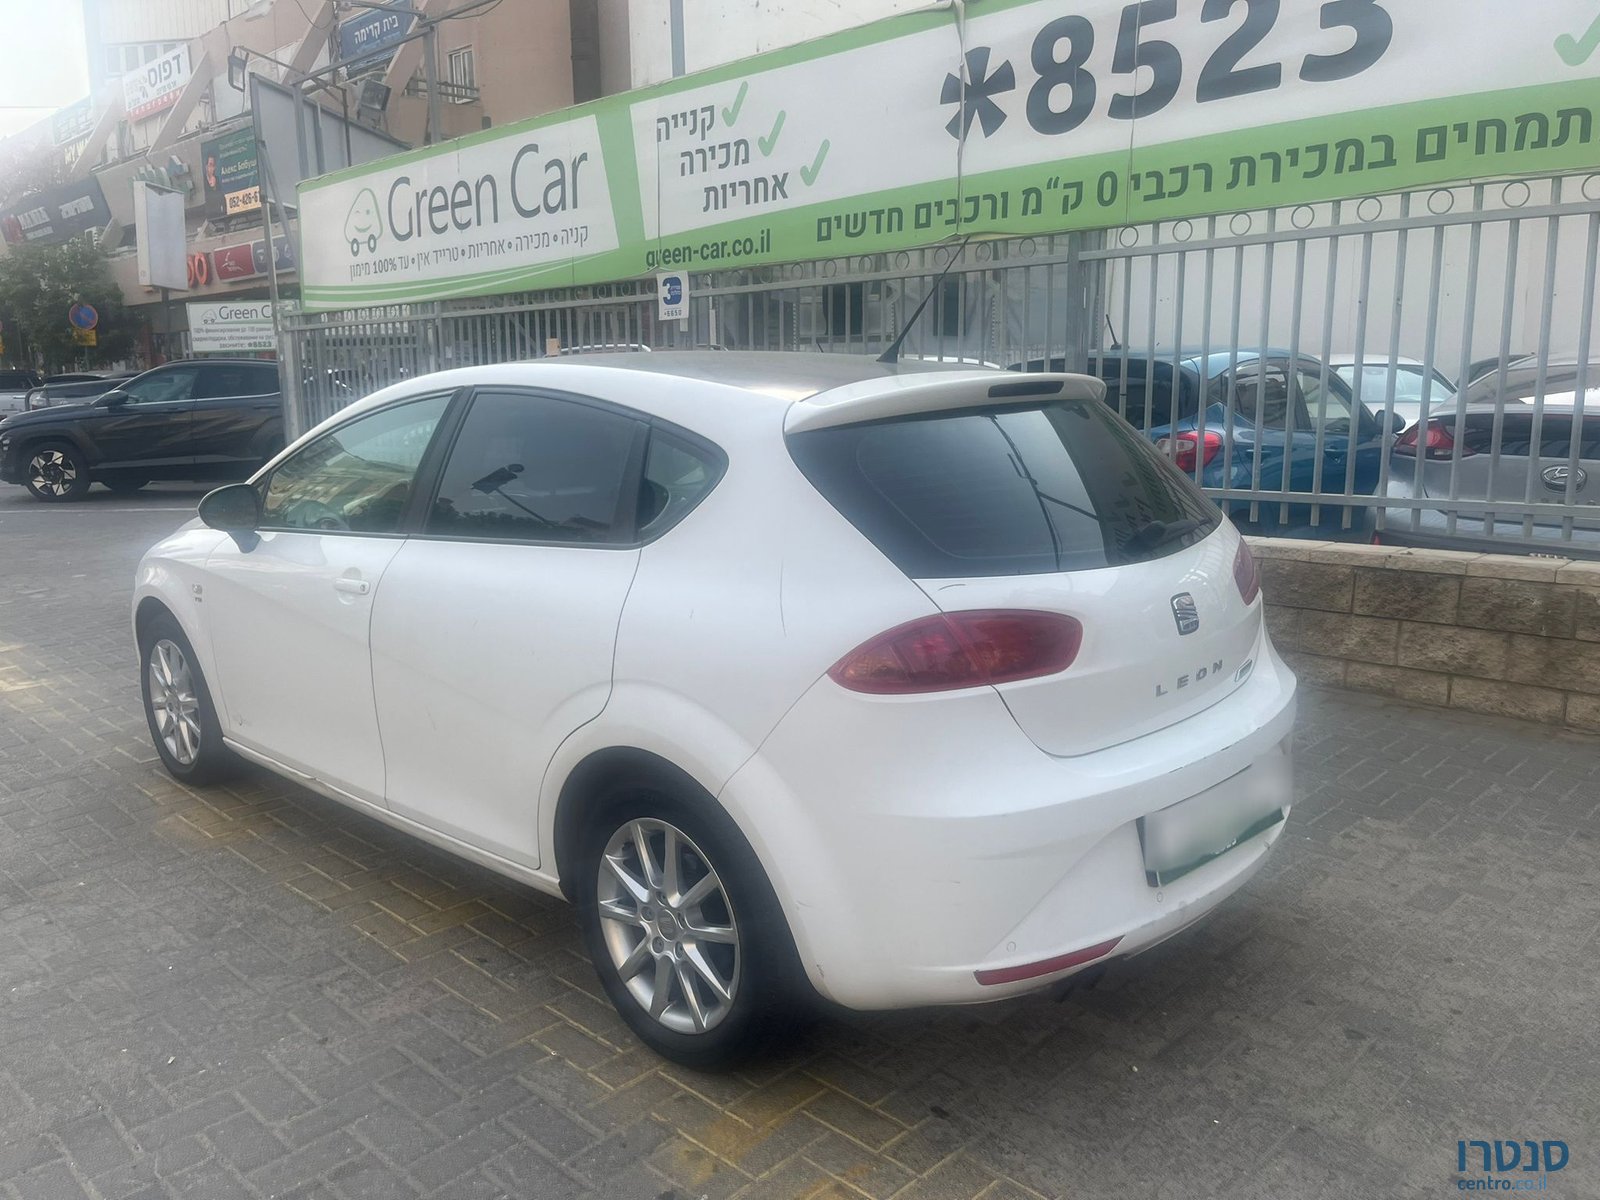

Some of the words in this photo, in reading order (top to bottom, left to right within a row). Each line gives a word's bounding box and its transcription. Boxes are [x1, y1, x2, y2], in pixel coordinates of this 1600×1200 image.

[382, 15, 399, 32] בית
[148, 53, 181, 88] דפוס
[656, 104, 715, 142] קנייה
[1415, 107, 1600, 164] תמחים
[680, 138, 750, 177] מכירה
[1226, 134, 1397, 190] במכירת
[387, 174, 499, 242] Green
[510, 143, 588, 219] Car
[703, 172, 789, 212] אחריות
[1096, 170, 1119, 208] 0
[1130, 162, 1213, 202] רכבי
[816, 205, 903, 243] חדשים
[914, 191, 1009, 230] ורכבים
[467, 239, 505, 259] אחריות
[515, 231, 550, 252] מכירה
[561, 225, 589, 247] קניה
[646, 228, 771, 270] green-car.co.il
[350, 261, 371, 281] מימון
[373, 258, 397, 274] 100%
[398, 256, 410, 270] עד
[417, 253, 430, 271] אין
[433, 247, 459, 264] טרייד
[218, 306, 258, 320] Green
[261, 304, 273, 319] C
[1155, 659, 1223, 697] LEON
